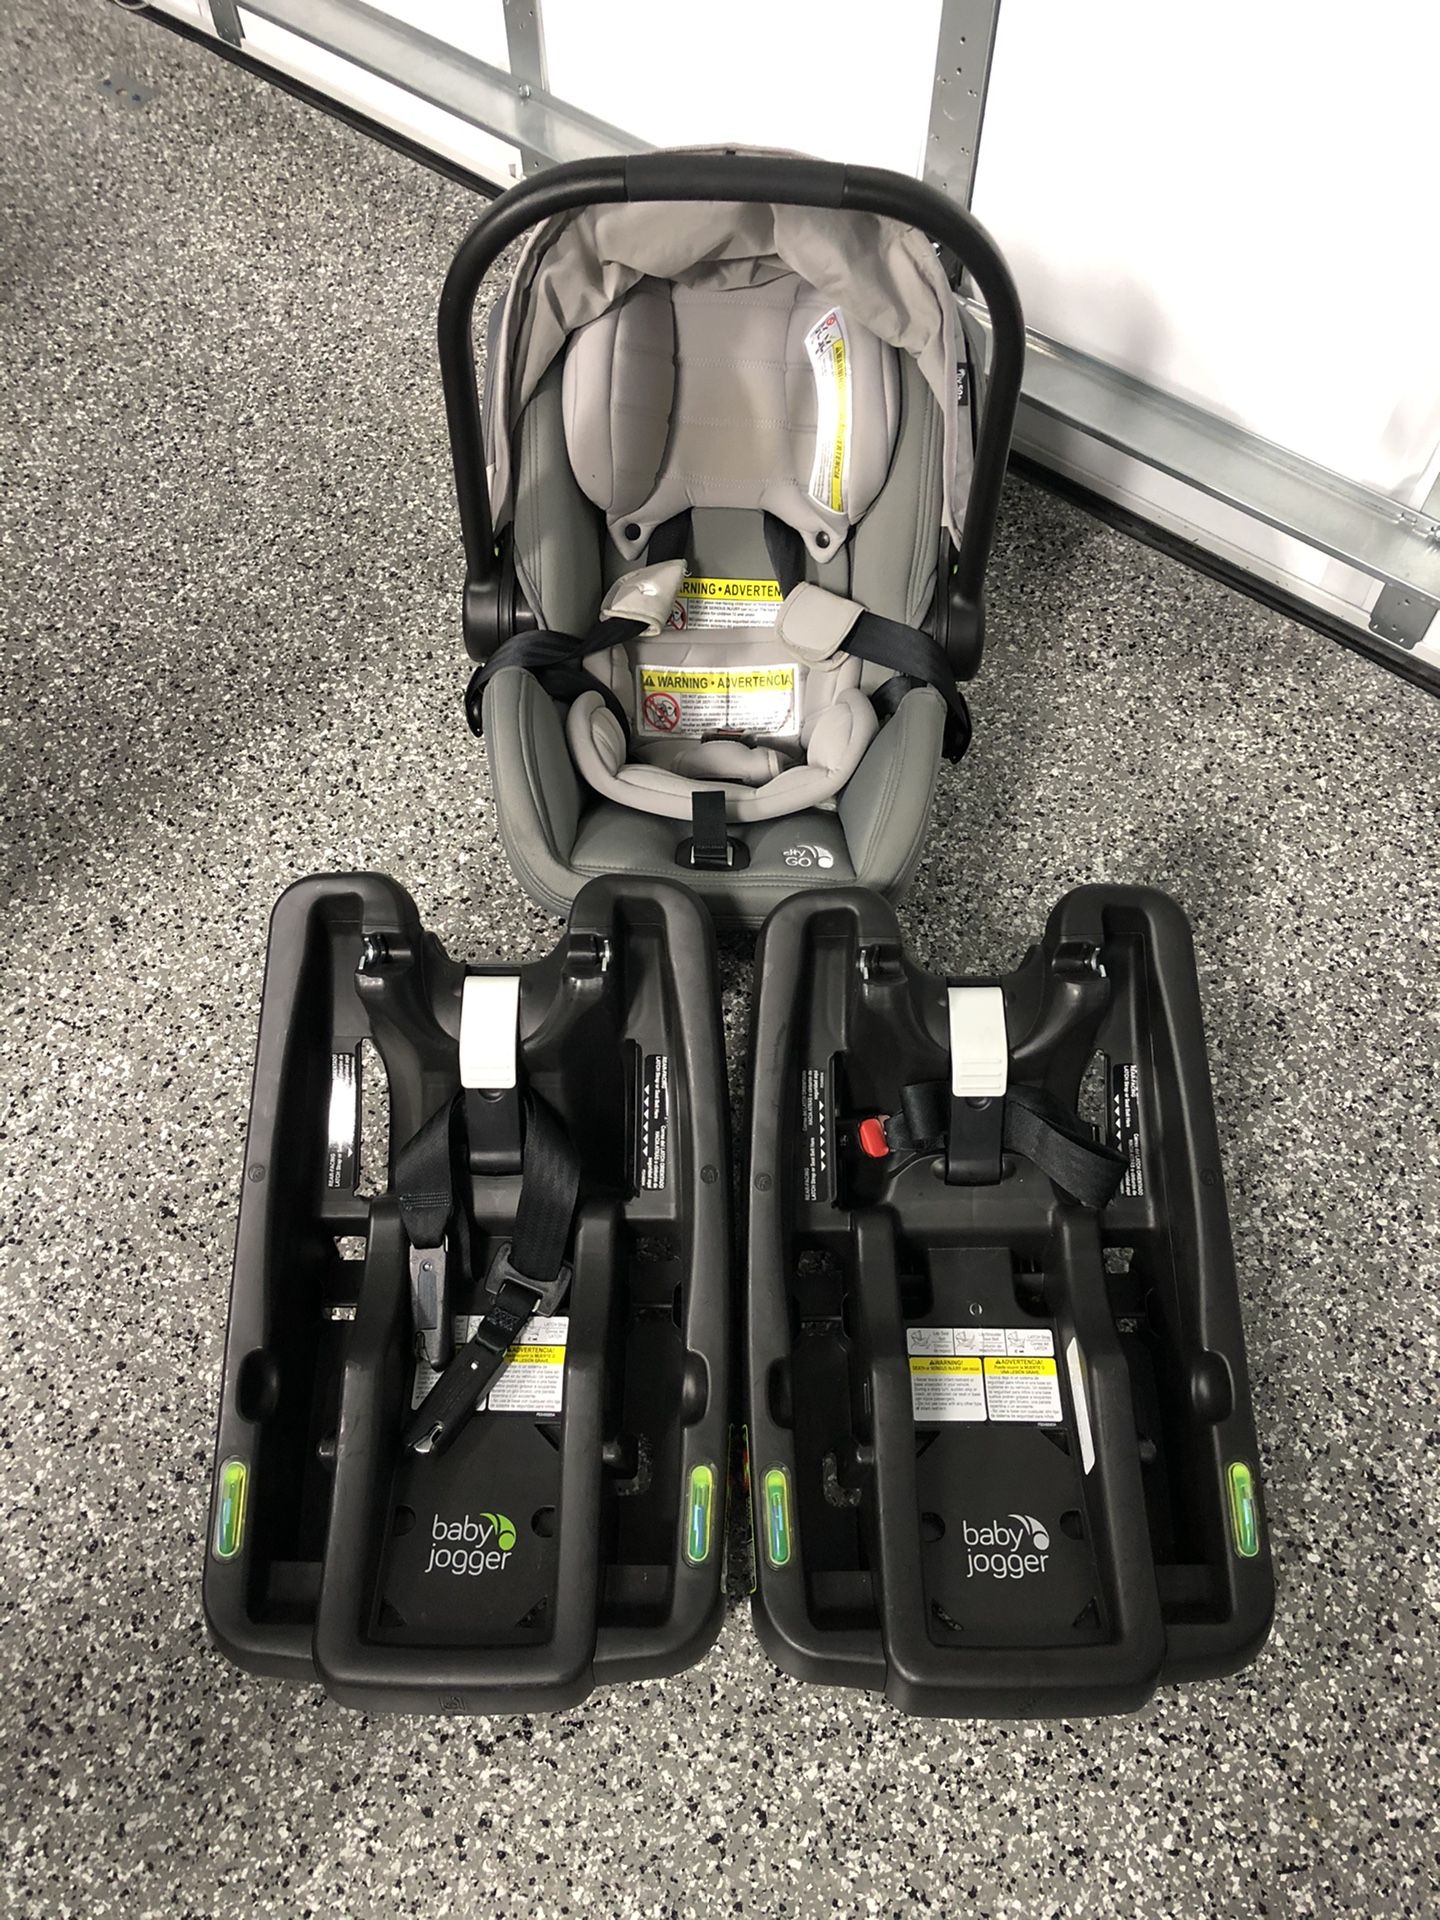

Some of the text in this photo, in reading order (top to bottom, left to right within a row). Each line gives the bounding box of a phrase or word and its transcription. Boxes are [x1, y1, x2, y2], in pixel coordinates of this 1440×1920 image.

[680, 581, 781, 596] RNING ADVERTEN
[658, 674, 793, 689] WARNING ADVERTENCIA
[783, 849, 806, 857] city
[785, 857, 811, 867] GO
[328, 1153, 336, 1187] REAR-FACING
[432, 1514, 493, 1548] baby
[963, 1520, 1023, 1552] baby
[425, 1543, 512, 1575] jogger
[967, 1549, 1049, 1579] jogger
